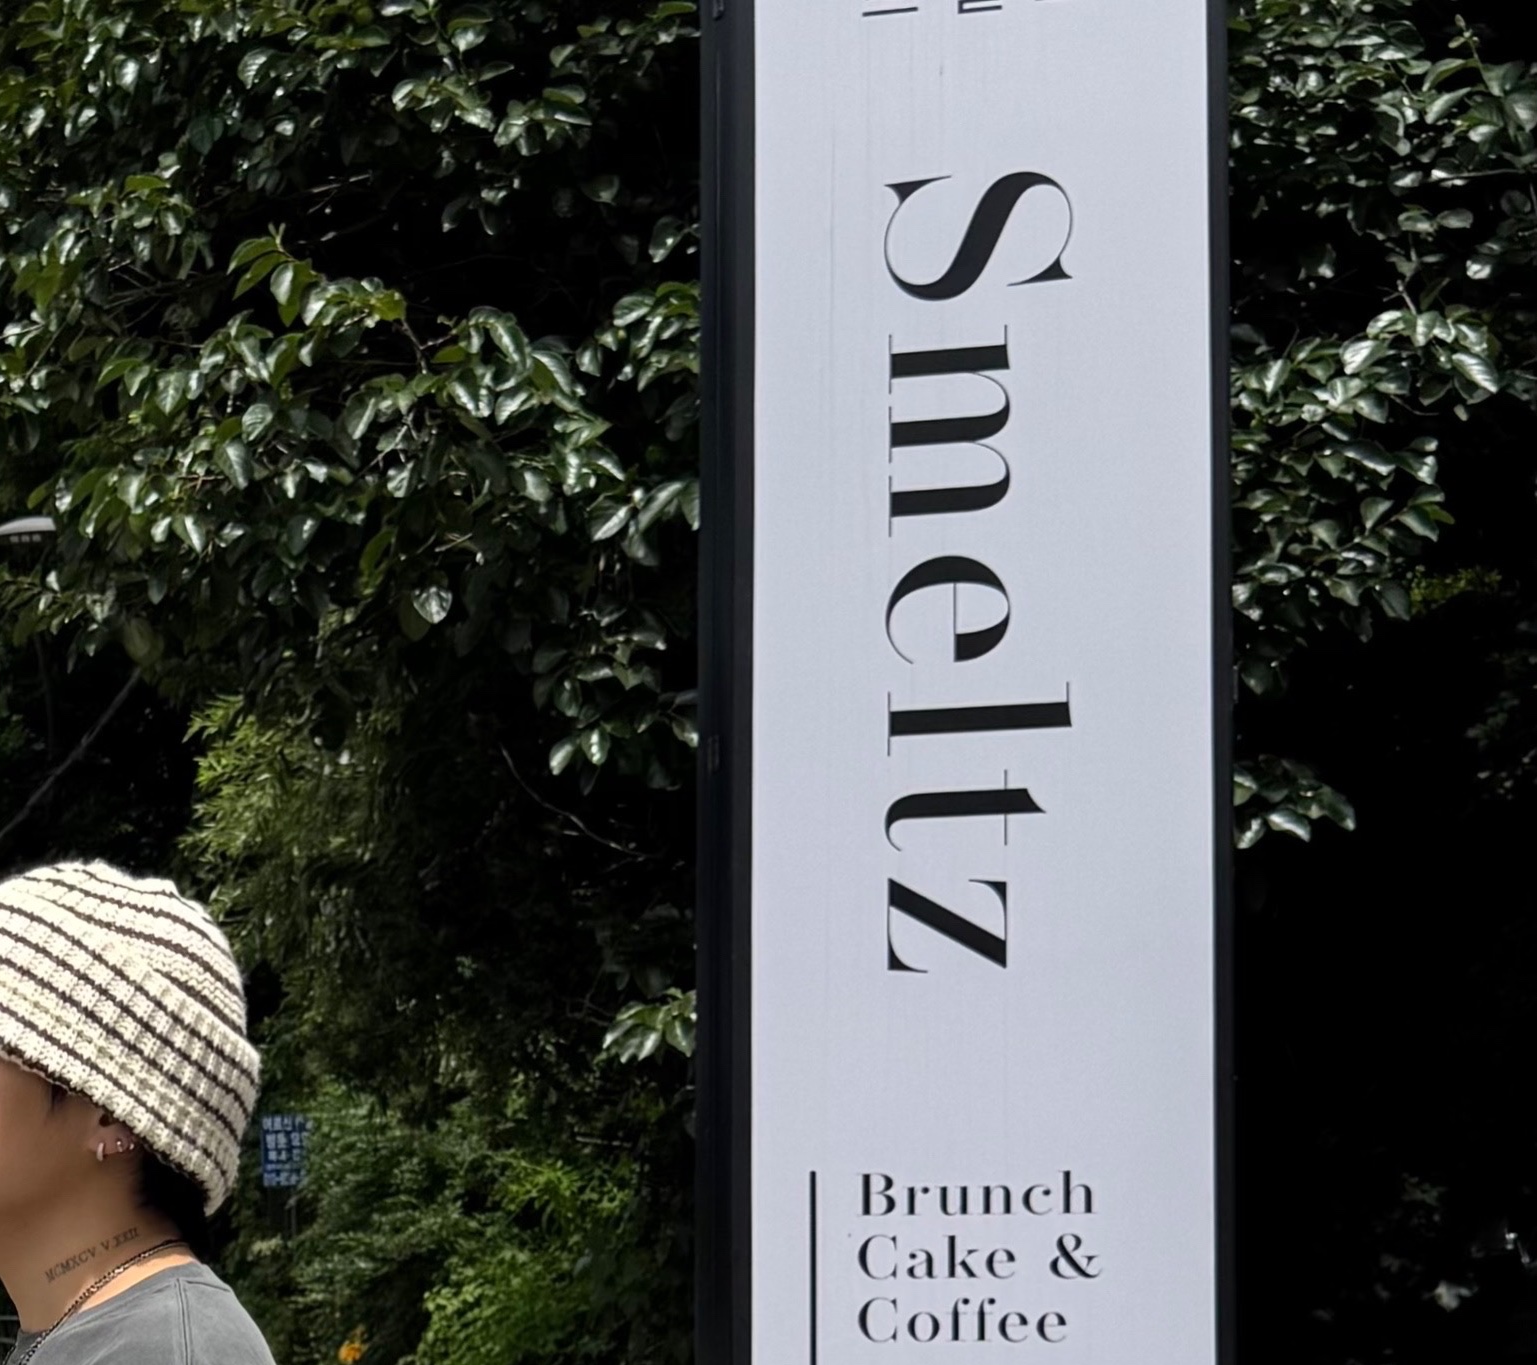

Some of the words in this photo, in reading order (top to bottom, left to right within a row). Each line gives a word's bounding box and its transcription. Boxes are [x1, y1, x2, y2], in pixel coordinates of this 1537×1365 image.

[883, 170, 1074, 974] Smeltz
[856, 1169, 1099, 1217] Brunch
[857, 1233, 1017, 1280] Cake
[1048, 1232, 1104, 1280] &
[857, 1296, 1068, 1344] Coffee
